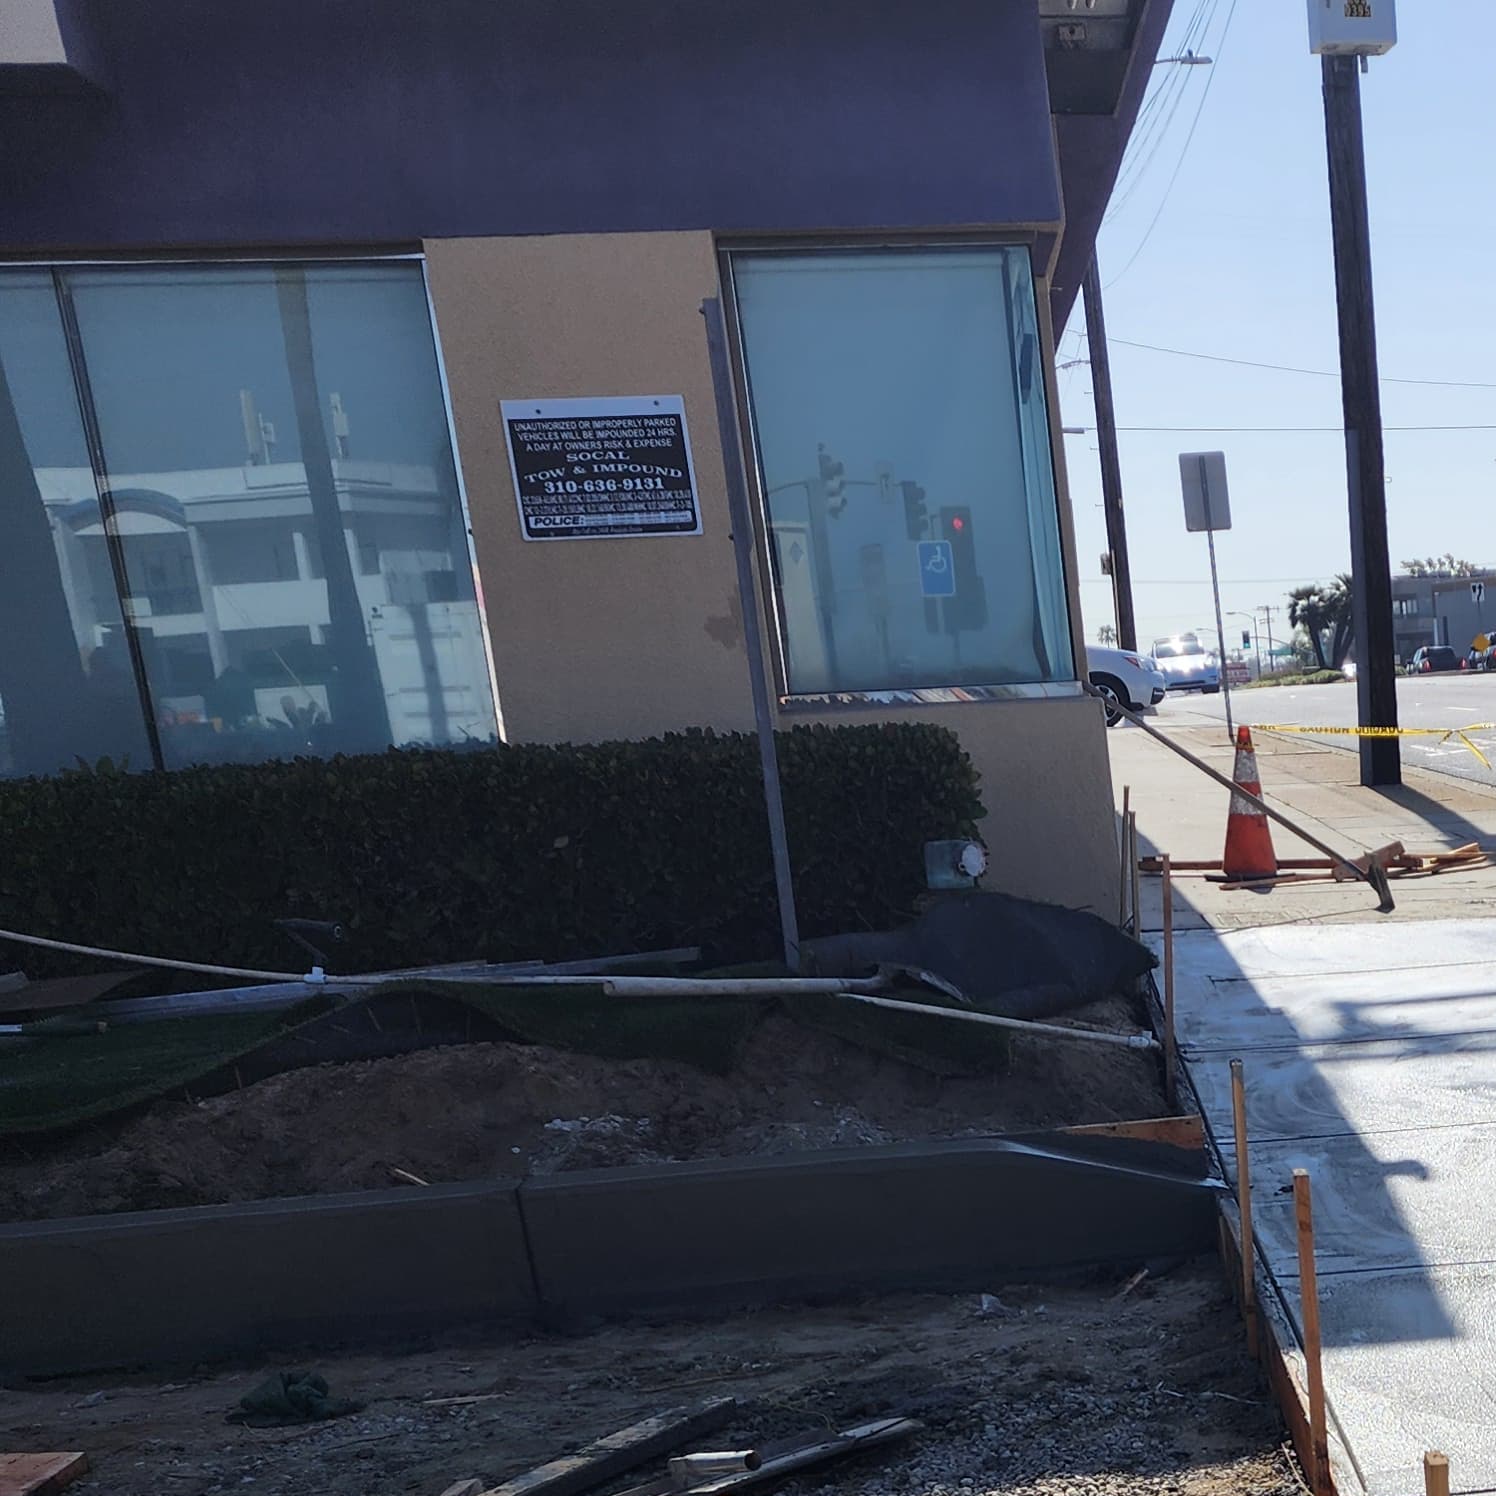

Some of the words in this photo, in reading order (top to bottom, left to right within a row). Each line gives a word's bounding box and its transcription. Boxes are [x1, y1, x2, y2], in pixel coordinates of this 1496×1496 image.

[514, 421, 577, 432] UNAUTHORIZED
[578, 420, 591, 430] OR
[592, 418, 642, 429] IMPROPERLY
[643, 417, 677, 428] PARKED
[518, 431, 560, 442] VEHICLES
[560, 431, 582, 440] WILL
[582, 430, 594, 440] BE
[595, 429, 645, 439] IMPOUNDED
[646, 428, 657, 437] 24
[526, 443, 534, 452] A
[534, 442, 551, 451] DAY
[552, 442, 563, 450] AT
[564, 440, 602, 450] OWNERS
[603, 439, 625, 449] RISK
[626, 439, 633, 448] &
[633, 438, 673, 448] EXPENSE
[565, 451, 630, 462] SOCAL
[524, 467, 566, 483] TOW
[572, 465, 586, 475] &
[592, 463, 683, 478] IMPOUND
[544, 477, 665, 494] 310-636-9131
[534, 516, 584, 526] POLICE:
